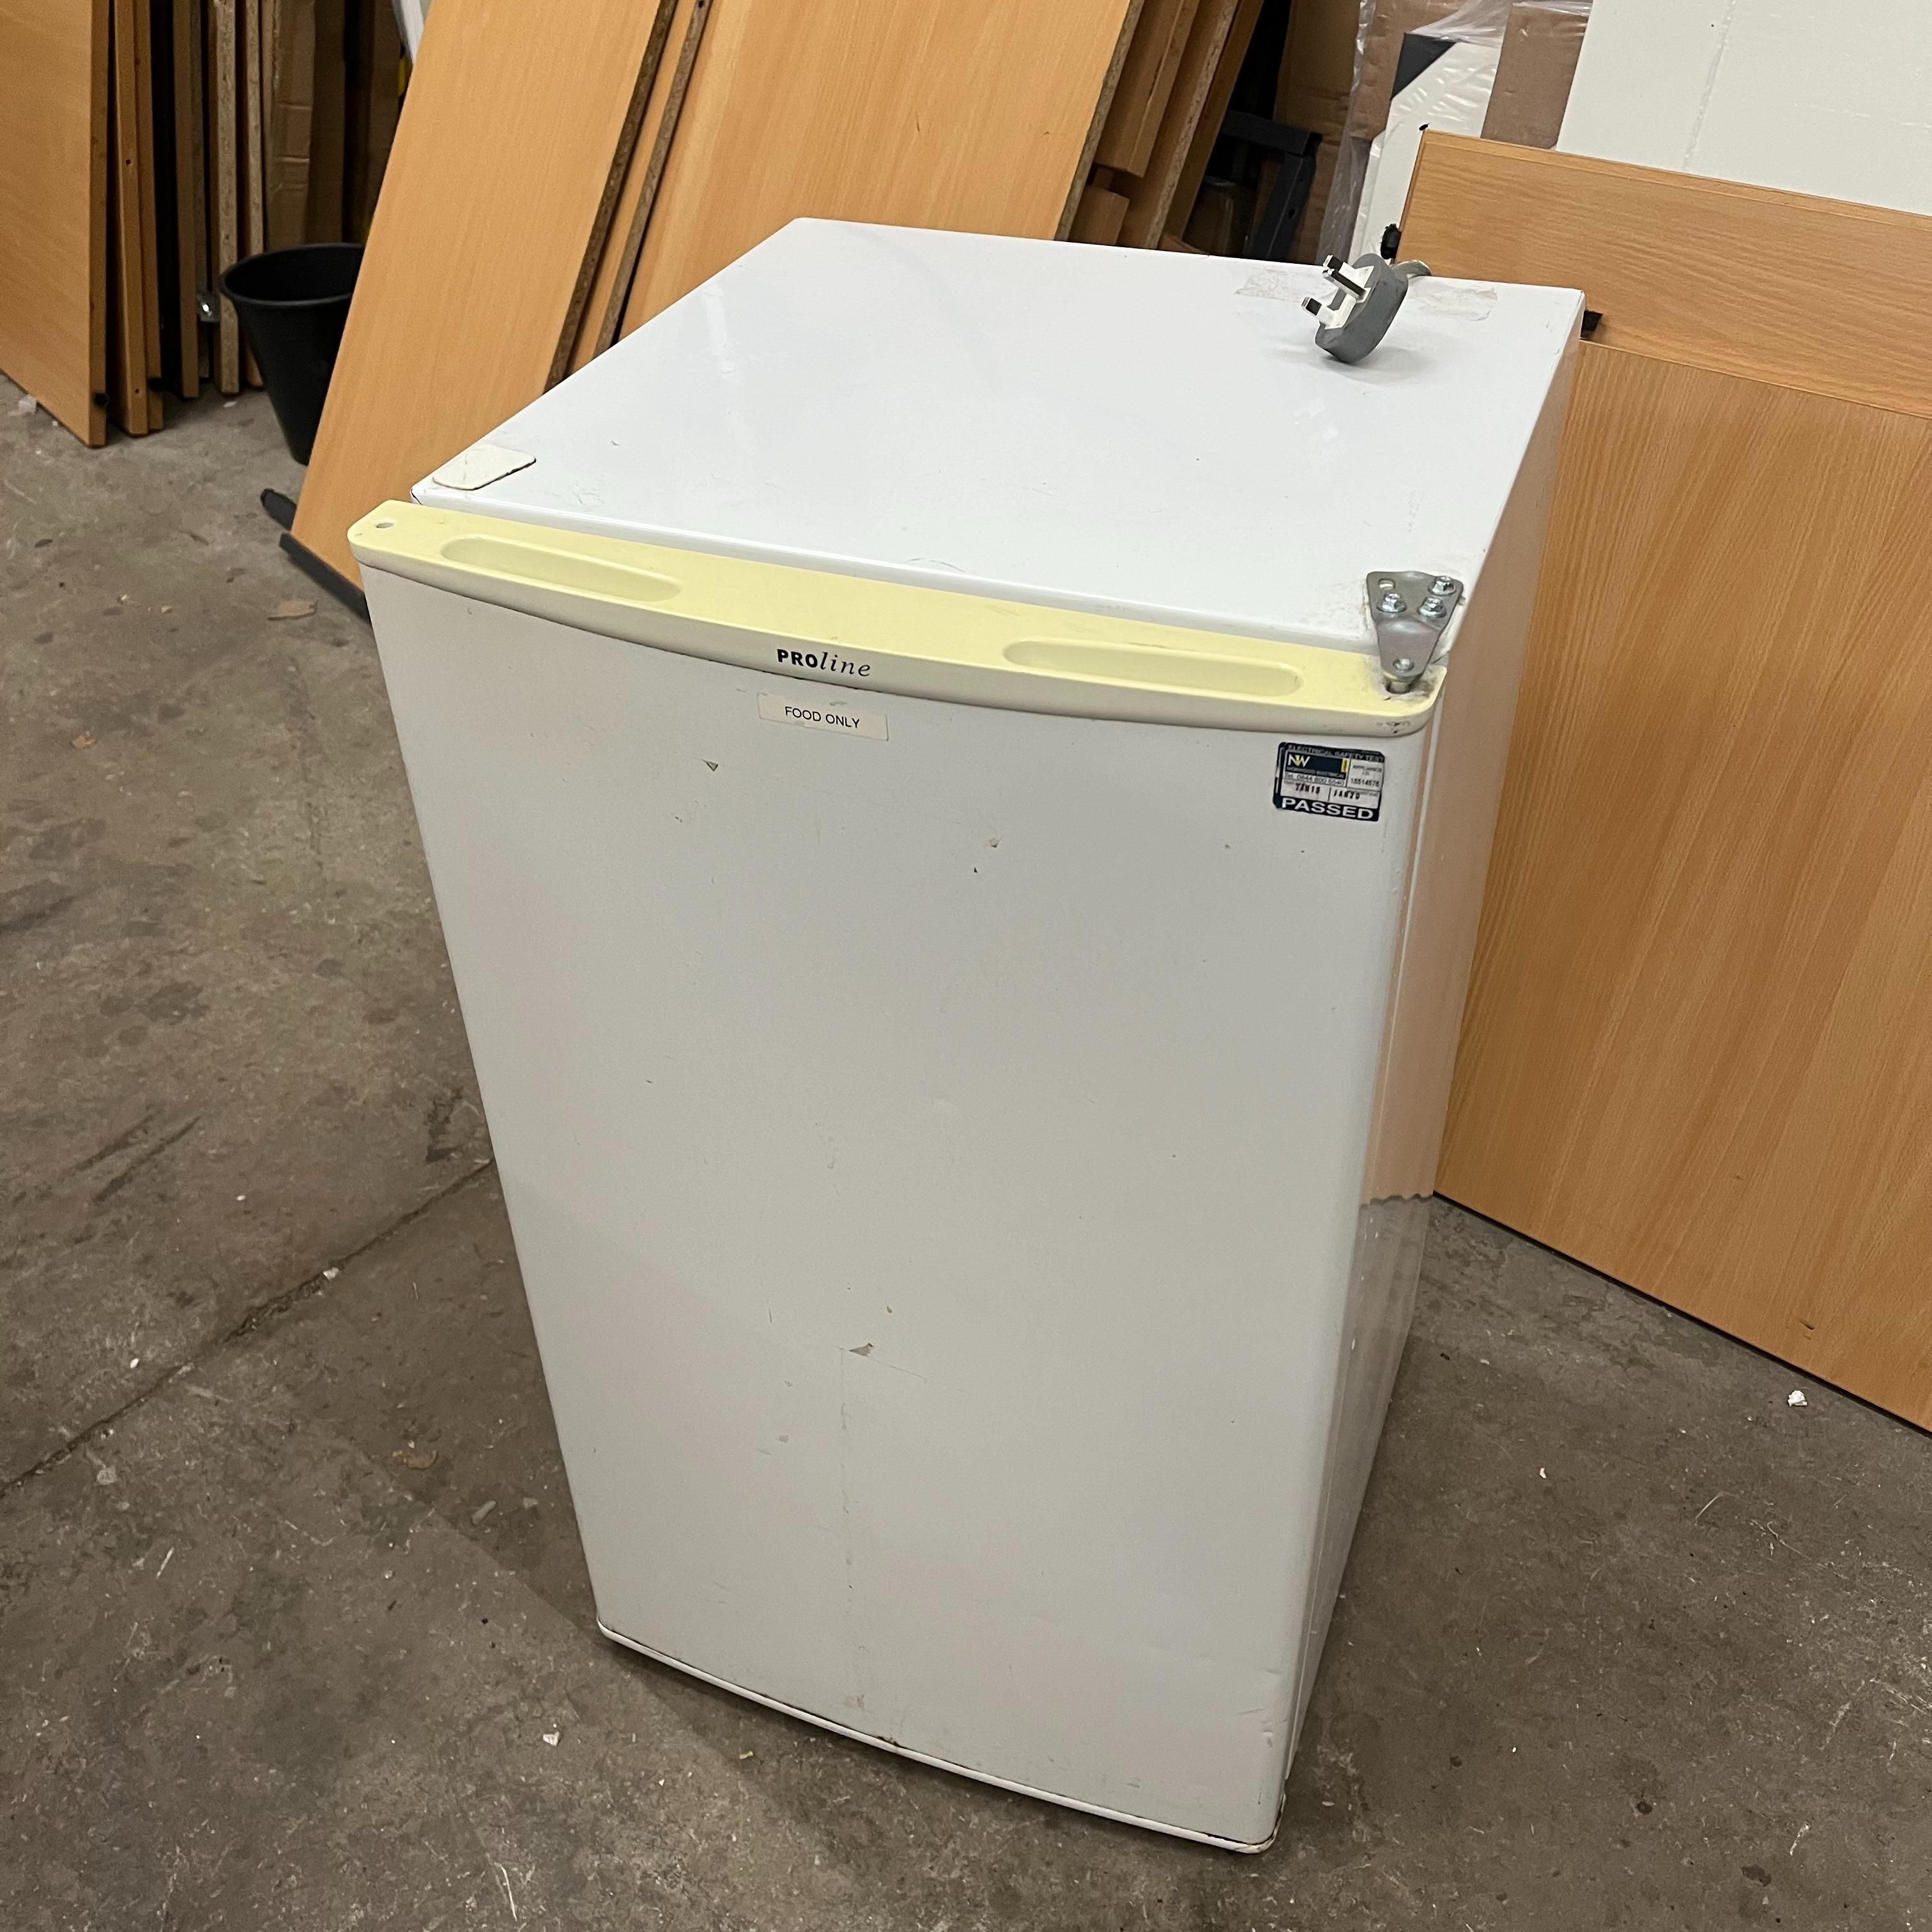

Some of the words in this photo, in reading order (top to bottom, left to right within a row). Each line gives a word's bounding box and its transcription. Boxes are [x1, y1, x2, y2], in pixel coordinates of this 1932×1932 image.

[777, 648, 871, 677] PROline
[785, 706, 822, 722] FOOD
[825, 714, 860, 728] ONLY
[1282, 797, 1374, 820] PASSED
